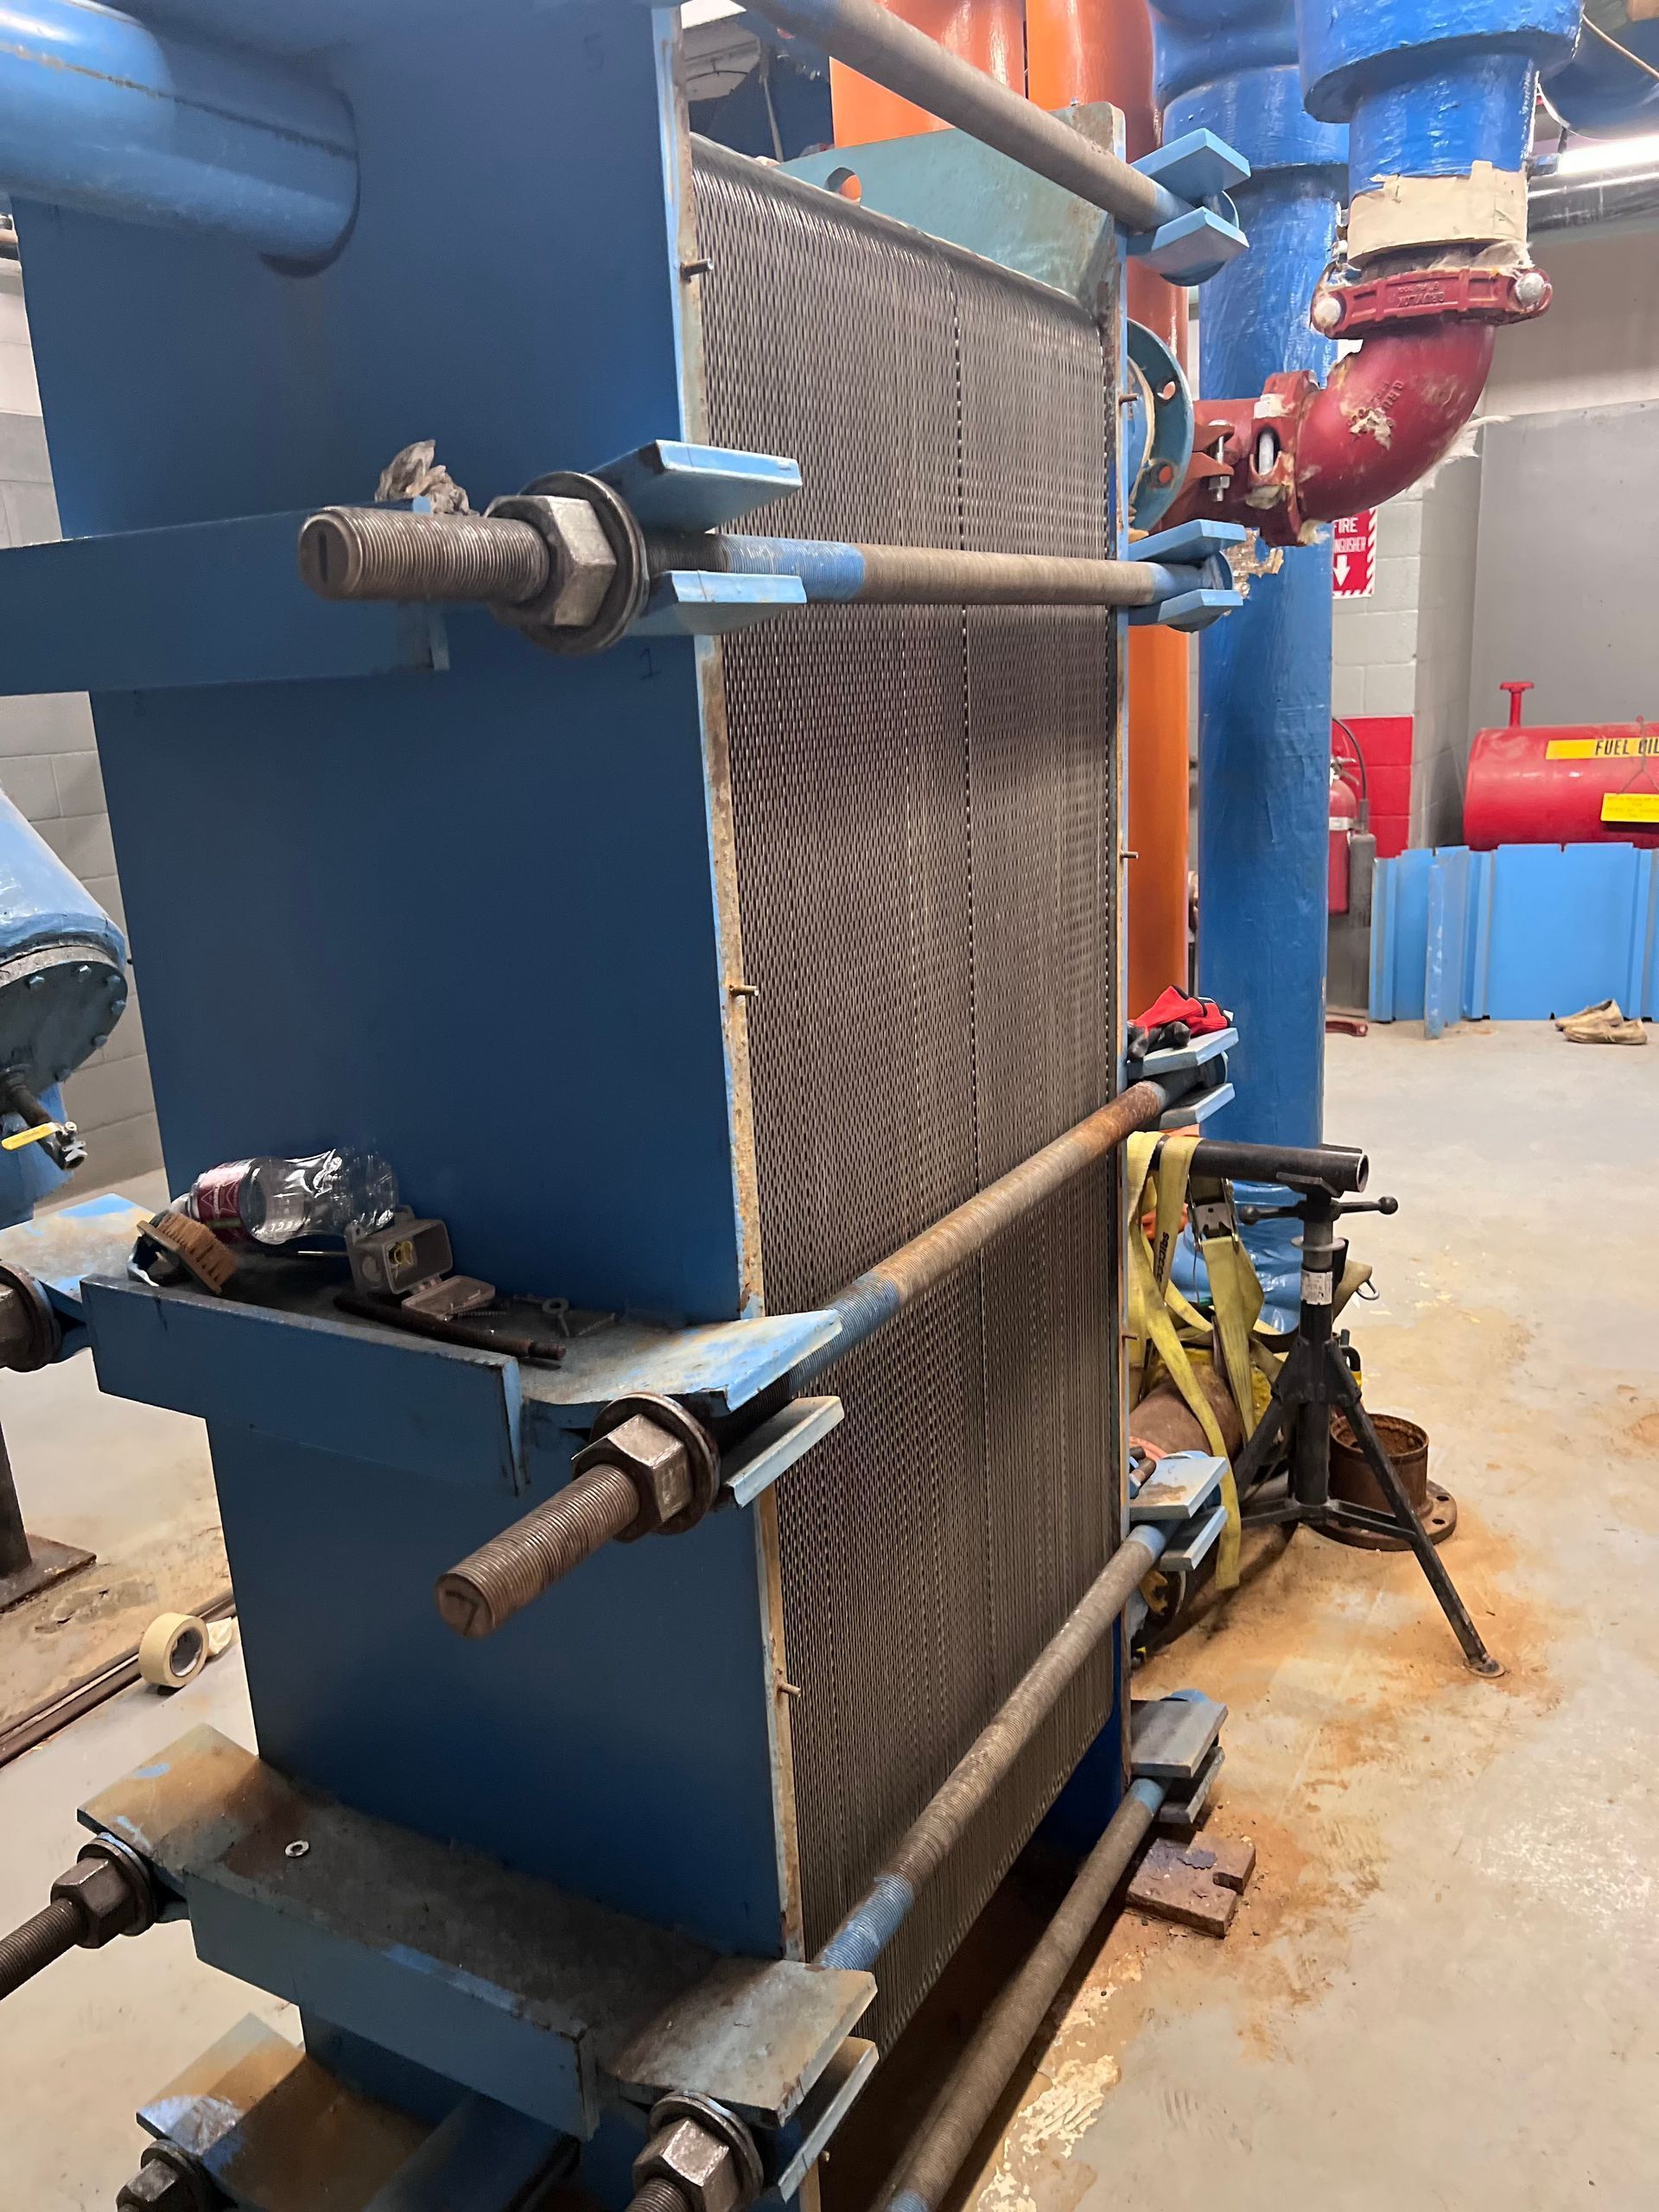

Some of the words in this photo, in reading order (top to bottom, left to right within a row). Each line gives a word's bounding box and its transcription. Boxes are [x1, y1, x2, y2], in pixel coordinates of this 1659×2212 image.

[639, 648, 663, 681] 1
[1595, 739, 1630, 755] FUEL
[1637, 738, 1659, 754] OIL
